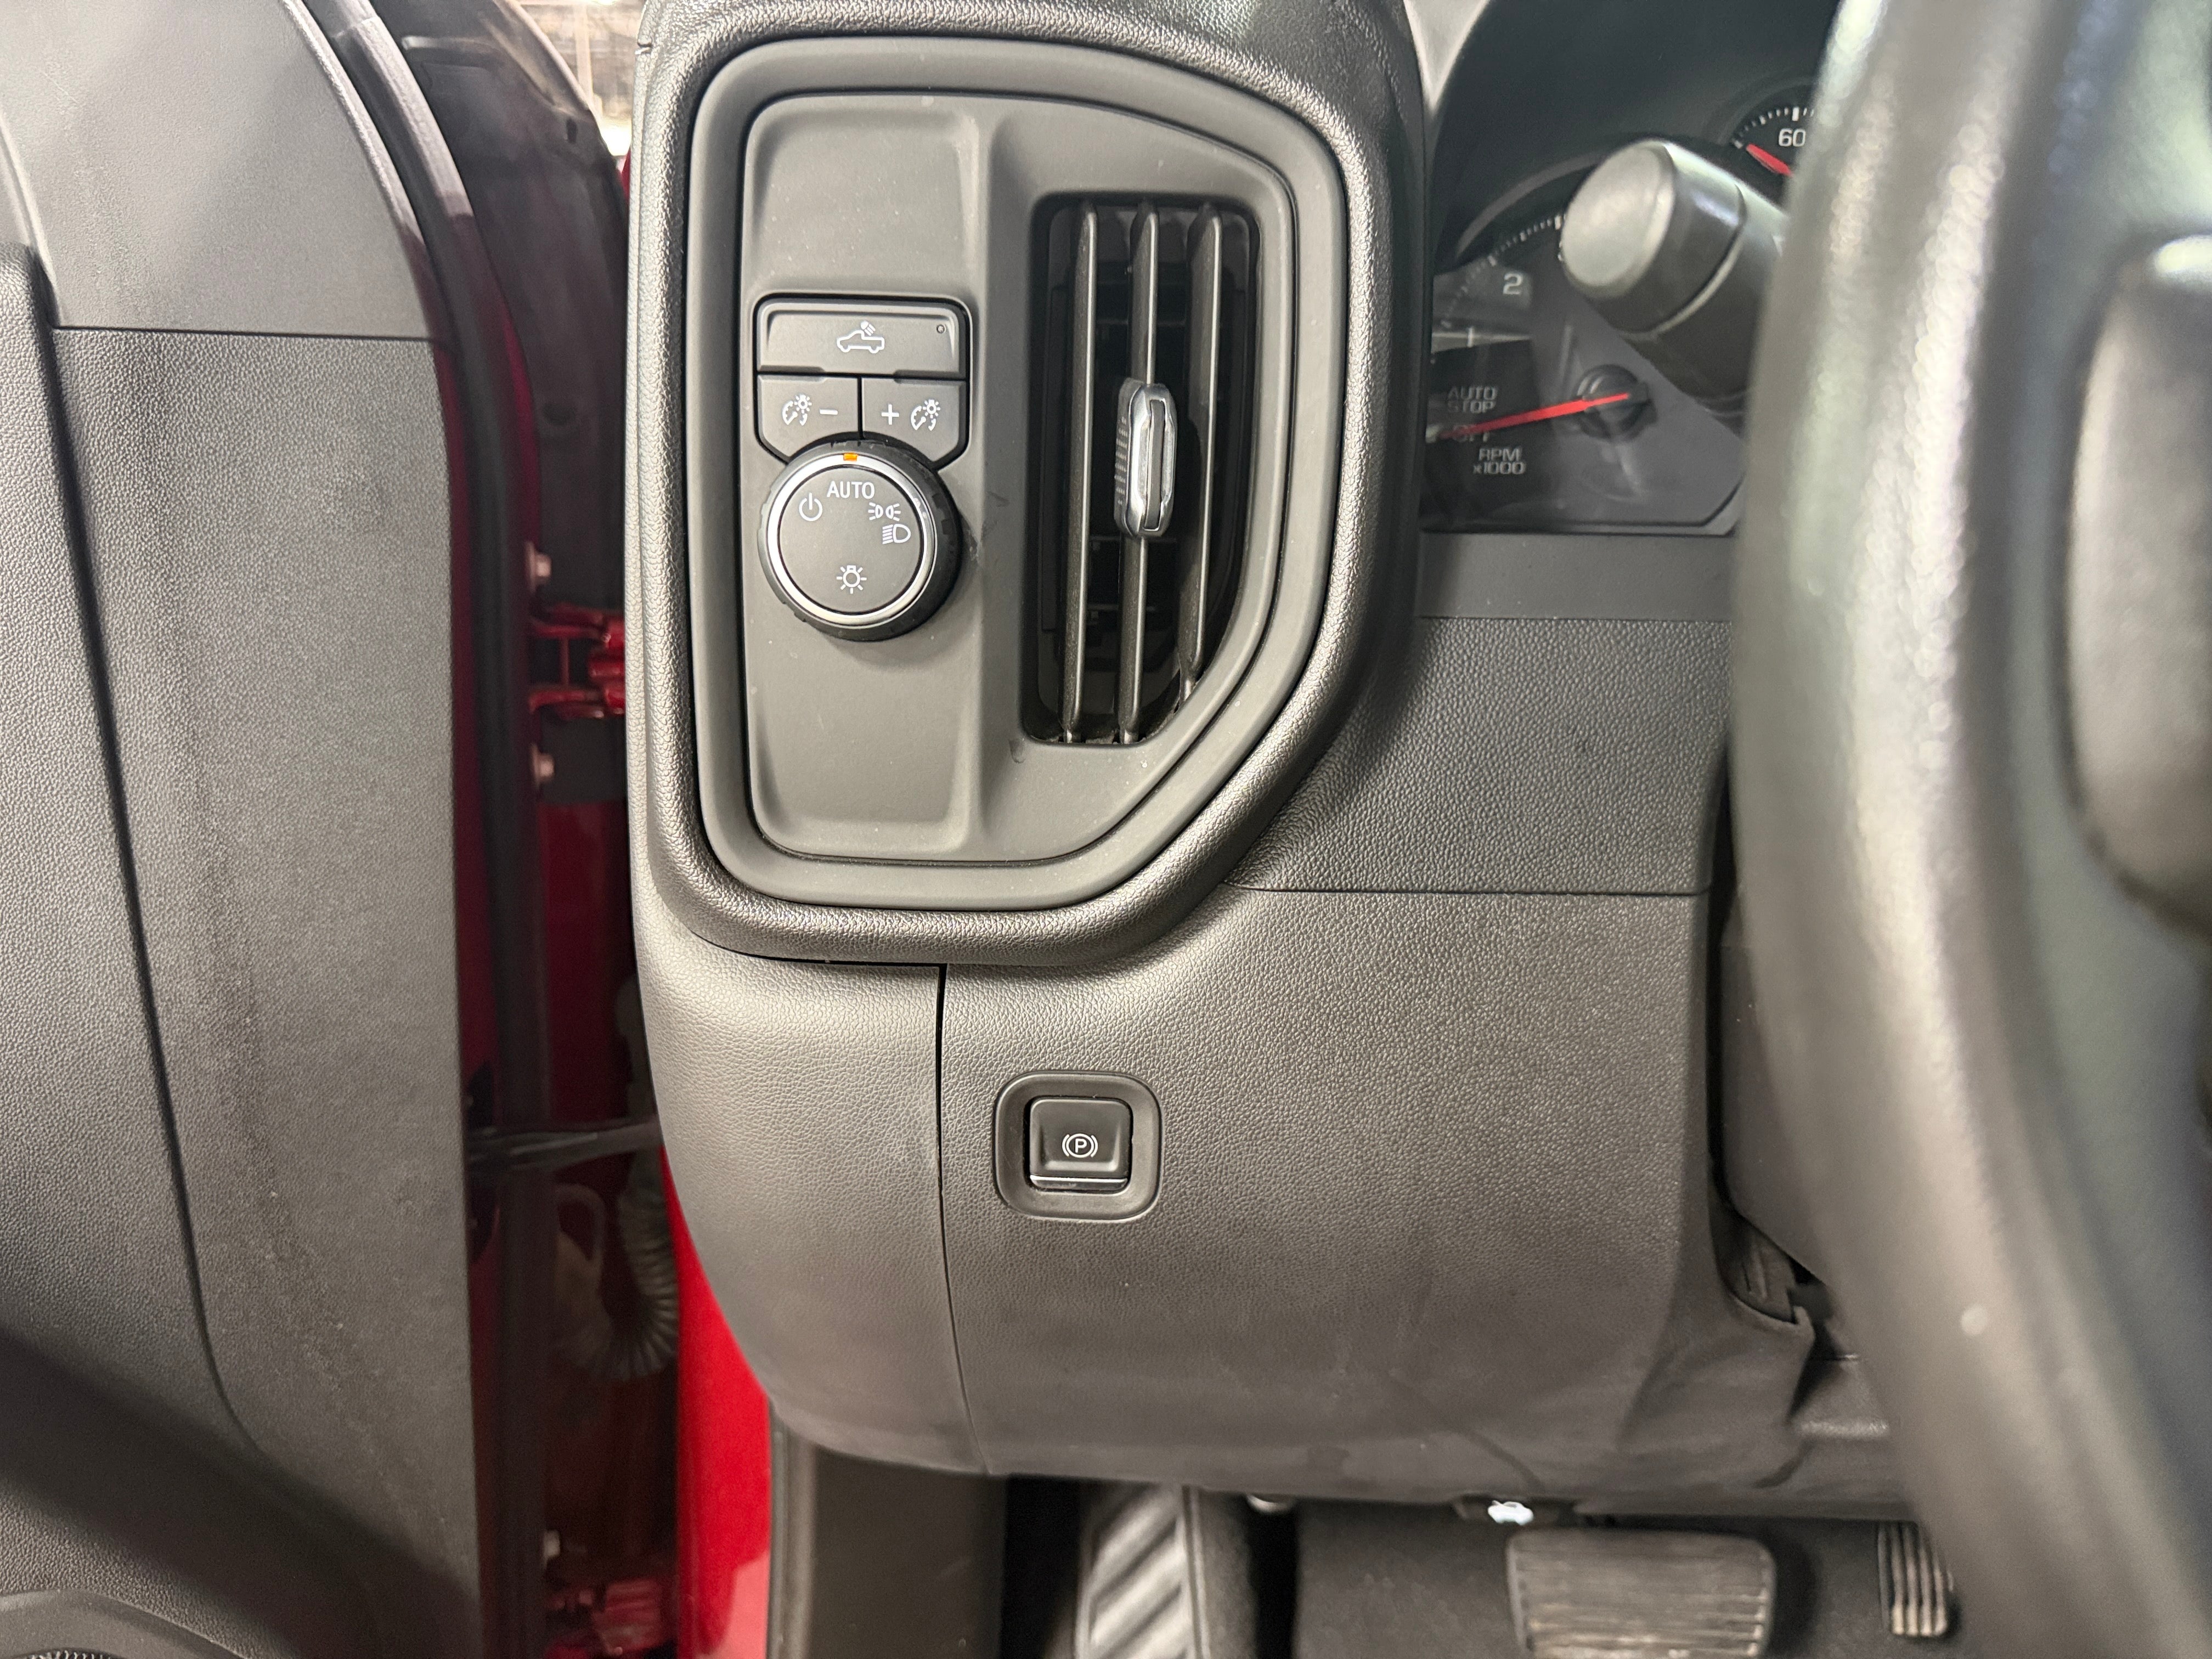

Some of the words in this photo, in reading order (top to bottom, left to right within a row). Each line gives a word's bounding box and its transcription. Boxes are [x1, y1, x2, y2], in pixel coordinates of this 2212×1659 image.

[1778, 127, 1807, 147] 60
[1503, 273, 1523, 295] 2
[1447, 386, 1498, 400] AUTO
[1447, 400, 1496, 413] STOP
[1478, 445, 1523, 461] RPM
[826, 480, 876, 499] AUTO
